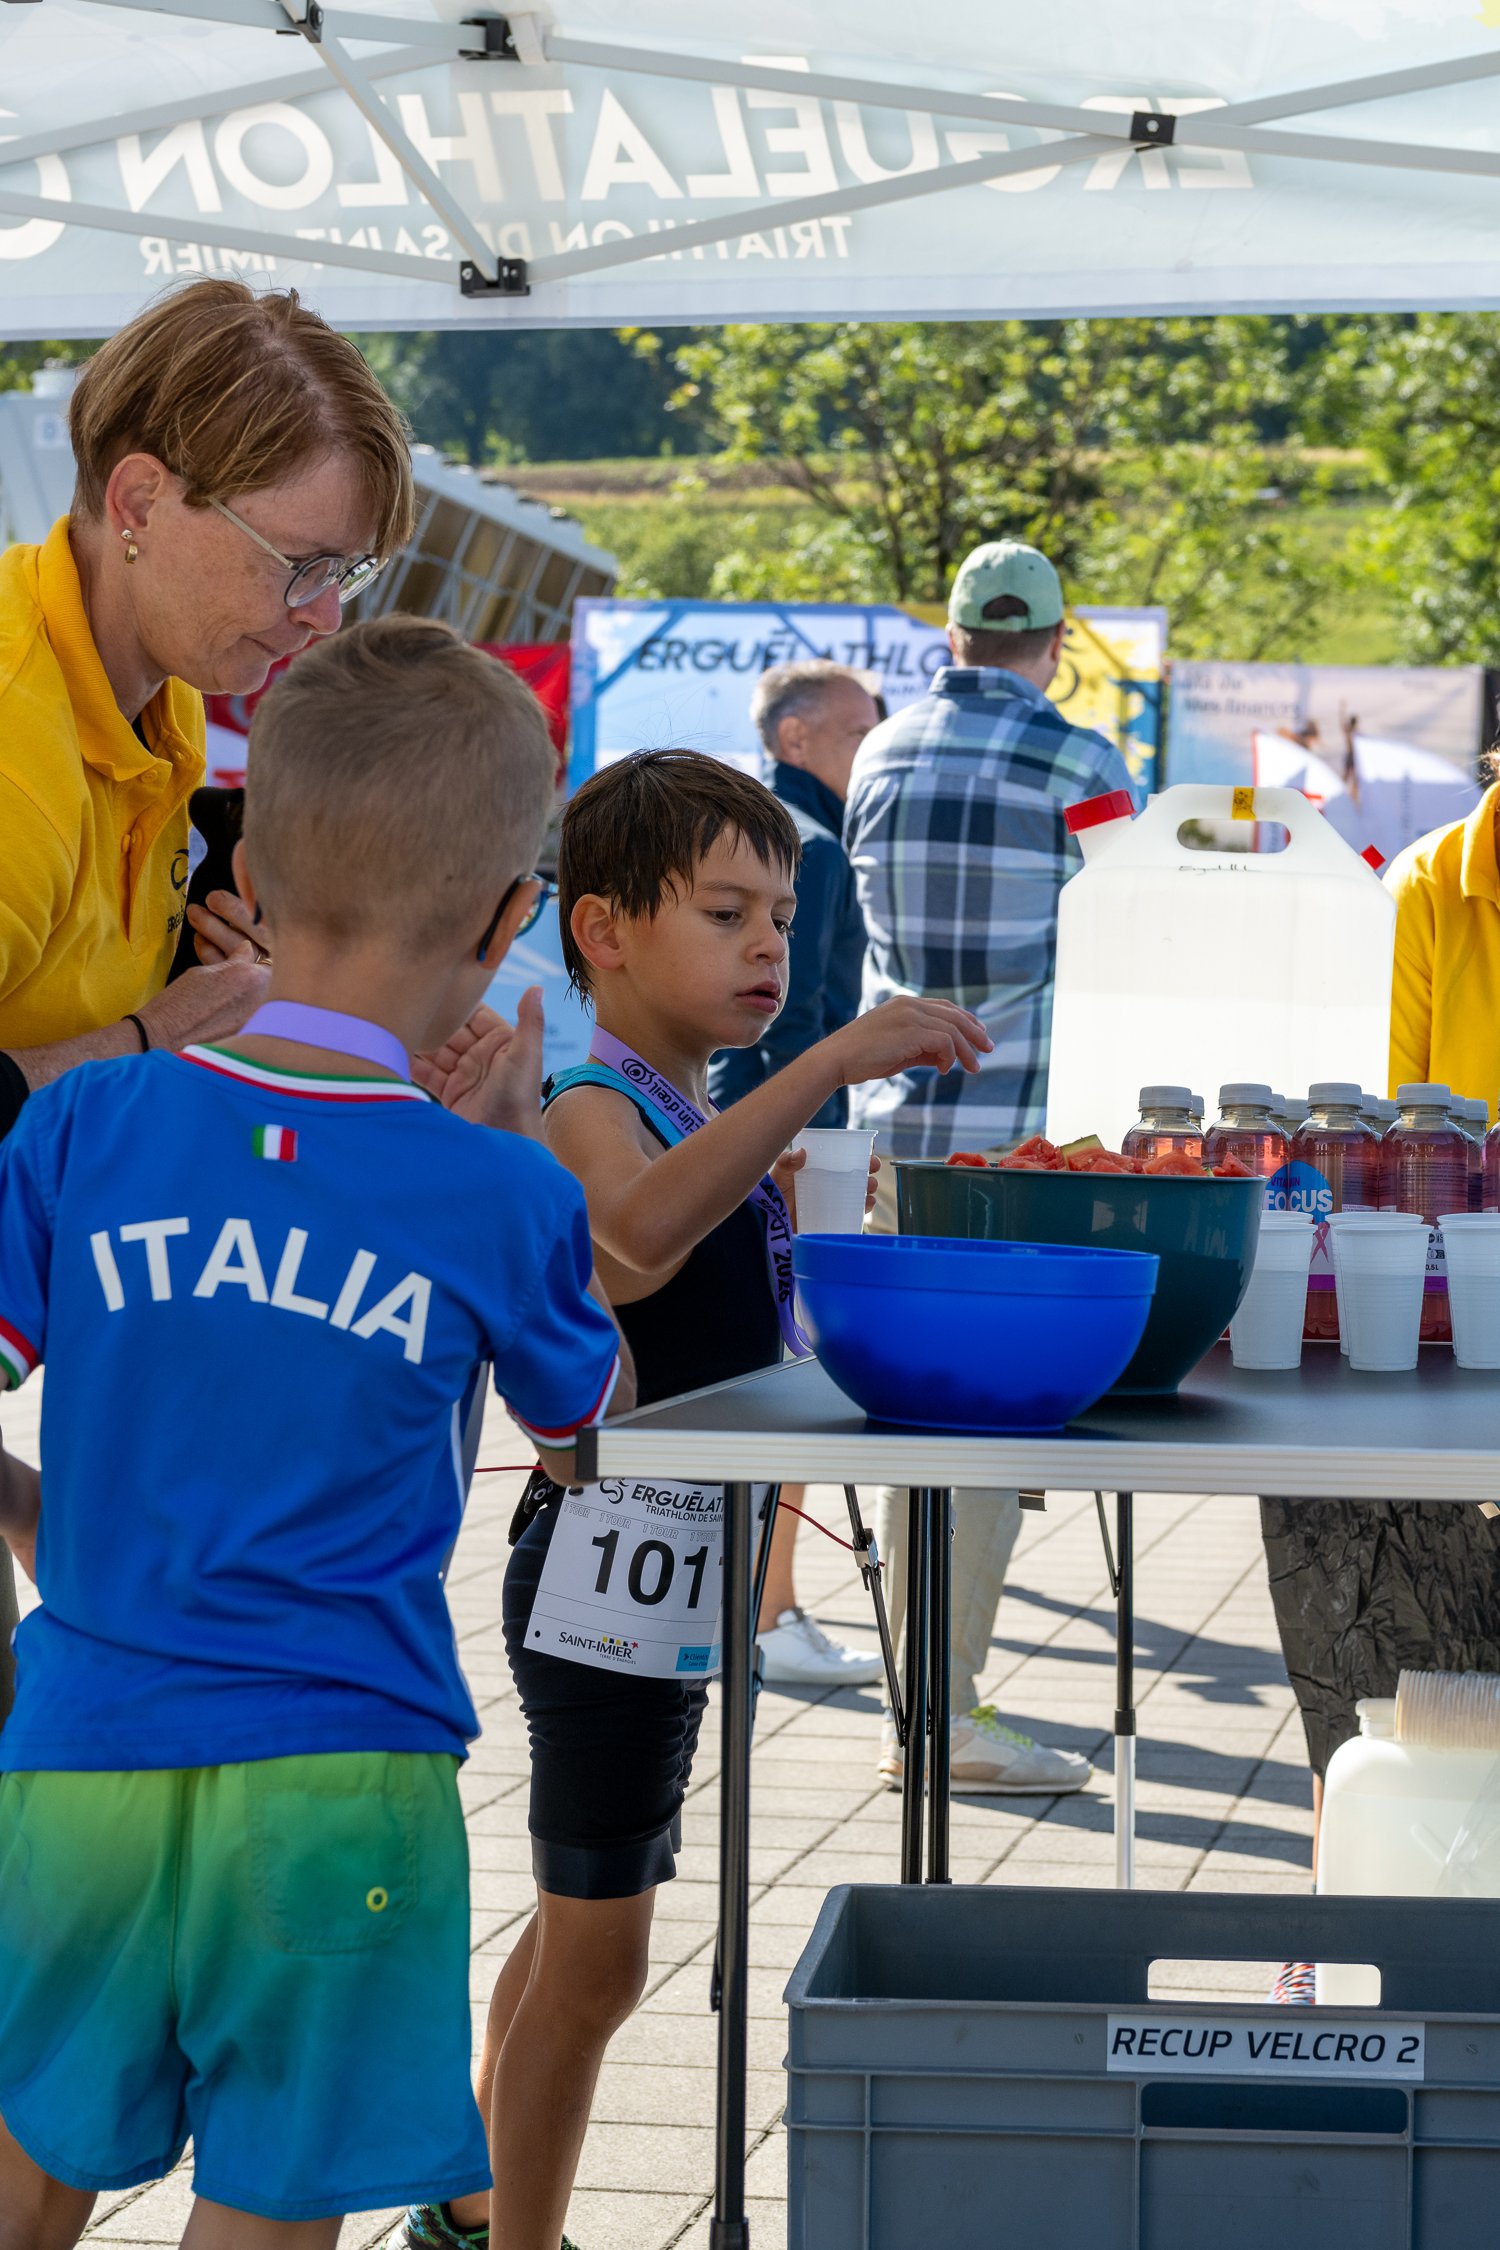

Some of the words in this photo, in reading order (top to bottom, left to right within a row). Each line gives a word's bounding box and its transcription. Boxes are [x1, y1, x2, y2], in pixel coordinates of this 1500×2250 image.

[1263, 1189, 1333, 1213] FOCUS
[90, 1216, 432, 1365] ITALIA
[568, 1504, 591, 1518] TOUR
[605, 1513, 631, 1529] TOUR
[645, 1504, 697, 1522] TRIATHLON
[698, 1513, 708, 1523] DE
[708, 1514, 724, 1523] SAIN
[649, 1524, 679, 1540] TOUR
[592, 1529, 724, 1609] 101
[559, 1631, 632, 1659] SAINT-IMIER
[1112, 2027, 1233, 2058] RECUP
[1247, 2031, 1386, 2063] VELCRO
[1396, 2036, 1420, 2064] 2
